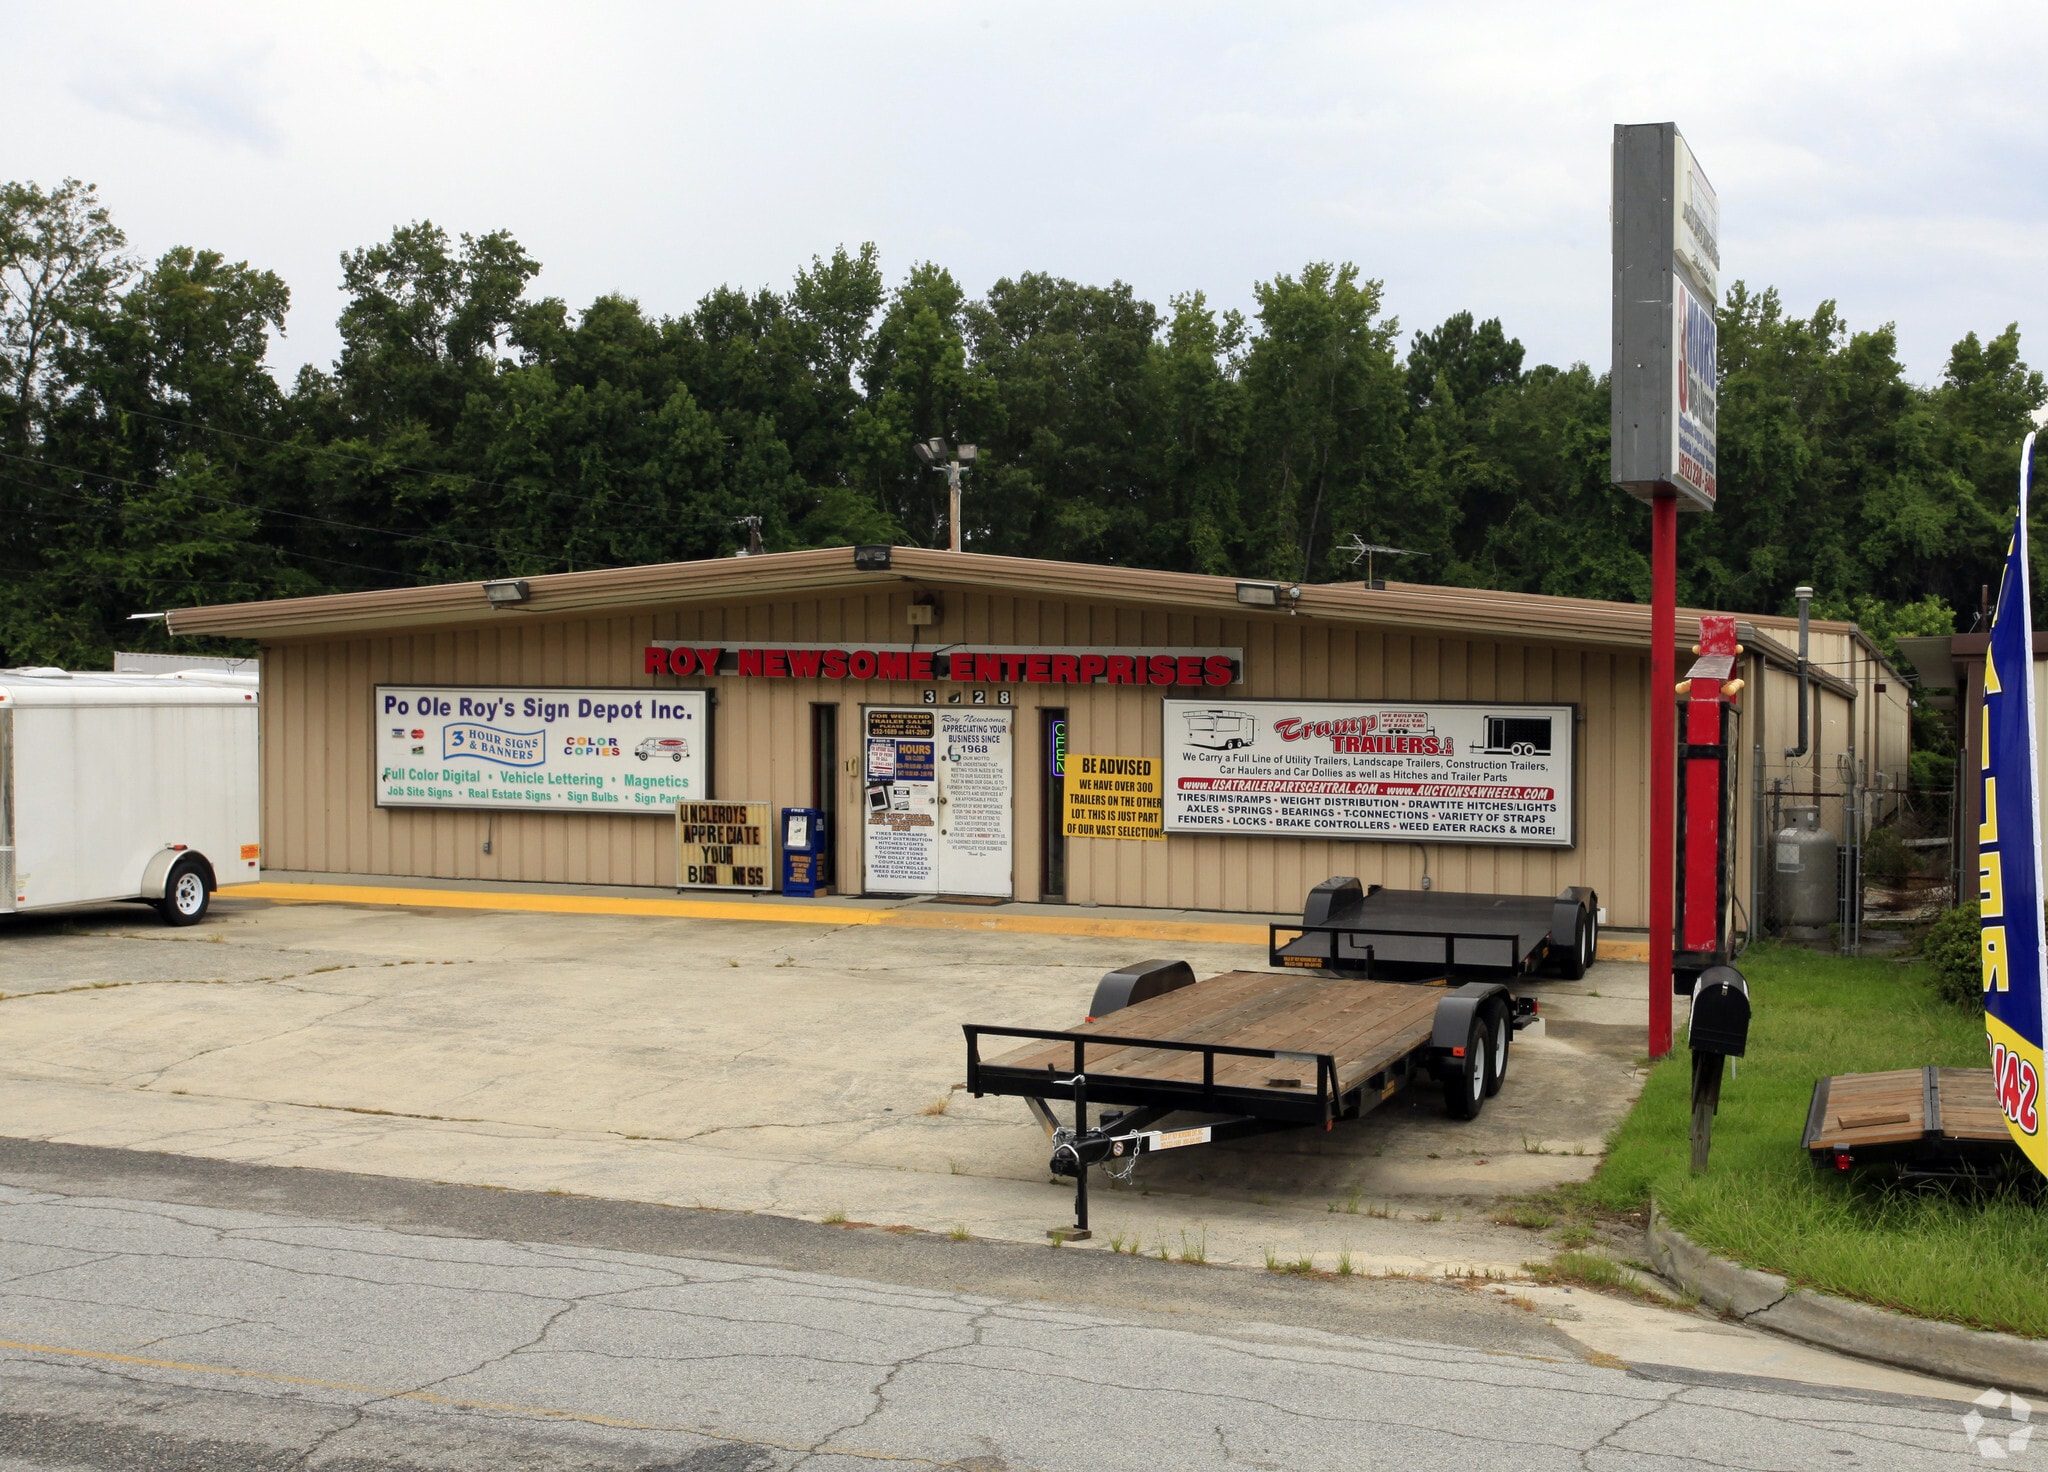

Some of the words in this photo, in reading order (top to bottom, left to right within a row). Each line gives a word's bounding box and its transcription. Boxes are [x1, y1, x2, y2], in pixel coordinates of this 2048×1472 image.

[1687, 293, 1716, 392] HOURS
[644, 646, 721, 676] ROY
[738, 649, 934, 680] NEWSOME
[950, 652, 1232, 686] ENTERPRISES
[385, 696, 409, 715] Po
[417, 697, 451, 716] Ole
[460, 698, 515, 721] Roy's
[524, 698, 569, 722] Sign
[579, 699, 642, 723] Depot
[652, 700, 692, 719] Inc.
[942, 715, 960, 723] Roy
[943, 725, 987, 733] APPRECIATING
[1274, 715, 1377, 742] Tramp
[452, 731, 464, 746] 3
[469, 730, 501, 744] HOUR
[505, 738, 538, 748] SIGNS
[567, 737, 617, 746] COLOR
[982, 735, 1000, 743] SINCE
[470, 741, 476, 749] &
[482, 742, 533, 760] BANNERS
[564, 747, 620, 756] COPIES
[899, 745, 931, 754] HOURS
[961, 745, 988, 753] 1968
[1082, 758, 1096, 773] BE
[1099, 759, 1151, 776] ADVISED
[1183, 753, 1196, 762] We
[1199, 753, 1222, 764] Carry
[1233, 754, 1249, 763] Full
[1252, 754, 1271, 763] Line
[1274, 755, 1283, 764] of
[1285, 756, 1311, 766] Utility
[1314, 756, 1350, 766] Trailers,
[1354, 757, 1403, 770] Landscape
[1406, 759, 1443, 769] Trailers,
[1446, 760, 1507, 770] Construction
[1510, 761, 1548, 771] Trailers,
[384, 768, 404, 780] Full
[409, 768, 438, 781] Color
[443, 769, 480, 784] Digital
[501, 771, 544, 784] Vehicle
[548, 772, 603, 788] Lettering
[625, 774, 689, 789] Magnetics
[1220, 766, 1234, 774] Car
[1238, 766, 1271, 775] Haulers
[1274, 767, 1291, 776] and
[1294, 768, 1309, 777] Car
[1312, 768, 1343, 778] Dollies
[1359, 770, 1377, 778] well
[1394, 771, 1428, 780] Hitches
[1431, 772, 1448, 780] and
[1451, 772, 1480, 781] Trailer
[1483, 773, 1507, 782] Parts
[1080, 779, 1091, 789] WE
[1094, 780, 1112, 790] HAVE
[1115, 781, 1134, 791] OVER
[1137, 782, 1152, 792] 300
[1183, 780, 1377, 795] www.USATRAILERPARTSCENTRAL.COM
[1387, 785, 1547, 800] www.AUCTIONS4WHEELS.COM
[388, 787, 404, 796] Job
[407, 787, 424, 796] Site
[428, 787, 452, 799] Signs
[469, 789, 488, 798] Real
[492, 789, 523, 799] Estate
[526, 790, 551, 802] Signs
[568, 791, 588, 802] Sign
[592, 793, 618, 802] Bulbs
[635, 793, 656, 804] Sign
[1070, 794, 1105, 805] TRAILERS
[1108, 796, 1118, 805] ON
[1120, 796, 1134, 806] THE
[1137, 798, 1161, 808] OTHER
[1177, 793, 1271, 804] TIRES/RIMS/RAMPS
[1280, 797, 1321, 805] WEIGHT
[1324, 798, 1398, 807] DISTRIBUTION
[1409, 801, 1463, 809] DRAWTITE
[1467, 802, 1556, 812] HITCHES/LIGHTS
[1072, 809, 1086, 819] LOT.
[1088, 809, 1105, 820] THIS
[1108, 811, 1115, 820] IS
[1118, 811, 1136, 822] JUST
[1138, 812, 1158, 823] PART
[1187, 805, 1218, 813] AXLES
[1228, 806, 1272, 815] SPRINGS
[1282, 808, 1334, 817] BEARINGS
[1344, 810, 1428, 819] T-CONNECTIONS
[1439, 812, 1483, 821] VARIETY
[1486, 813, 1499, 822] OF
[1504, 814, 1545, 823] STRAPS
[1067, 823, 1076, 833] OF
[1078, 824, 1094, 834] OUR
[1096, 825, 1116, 835] VAST
[1178, 815, 1223, 824] FENDERS
[1233, 817, 1267, 825] LOCKS
[1276, 819, 1311, 827] BRAKE
[1314, 820, 1390, 829] CONTROLLERS
[1400, 822, 1429, 831] WEED
[1433, 823, 1465, 832] EATER
[1470, 824, 1505, 833] RACKS
[1510, 826, 1517, 834] &
[1521, 826, 1555, 835] MORE!
[684, 825, 759, 845] APPRECIATE
[701, 846, 733, 864] YOUR
